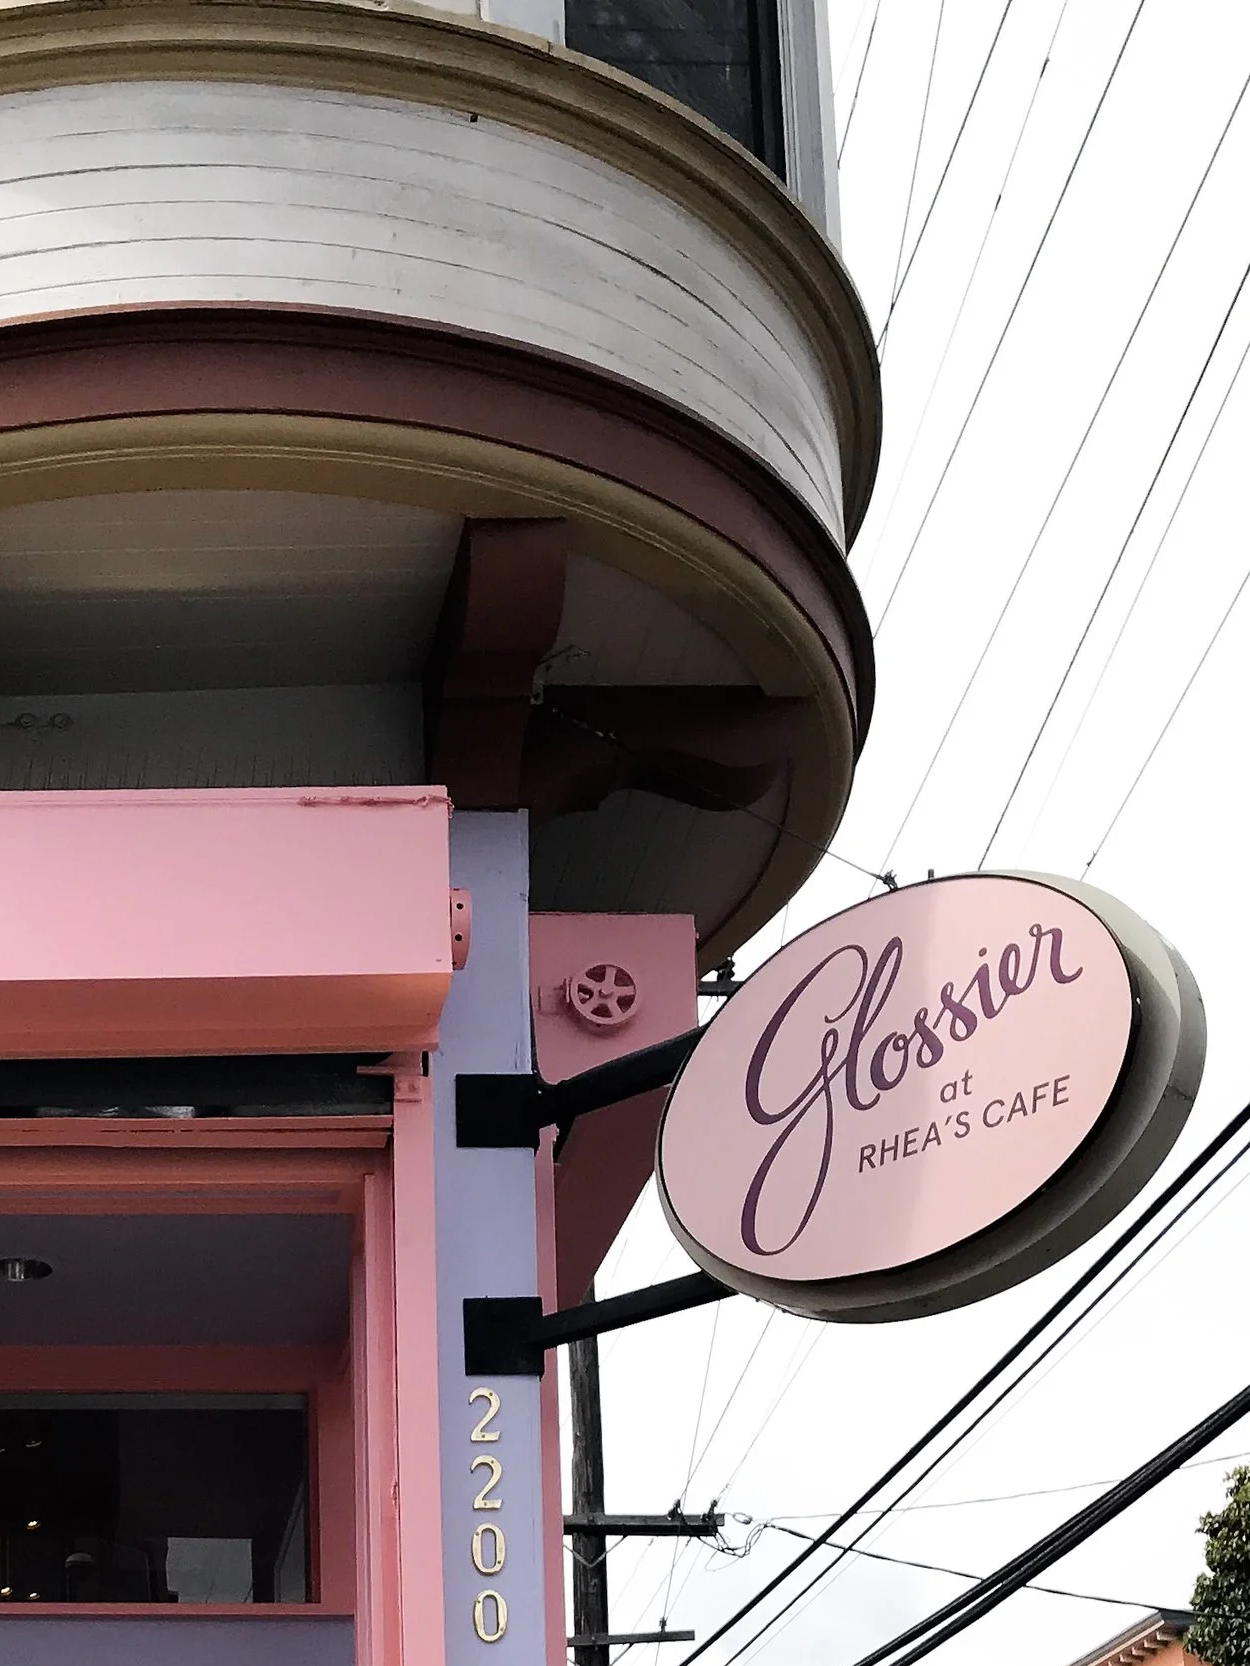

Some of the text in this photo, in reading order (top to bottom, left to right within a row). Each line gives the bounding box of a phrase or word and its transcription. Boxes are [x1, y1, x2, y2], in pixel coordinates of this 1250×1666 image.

[740, 923, 1083, 1256] Glossier
[858, 1074, 1071, 1174] RHEA'S CAFE
[940, 1069, 974, 1103] at
[468, 1386, 509, 1643] 2200
